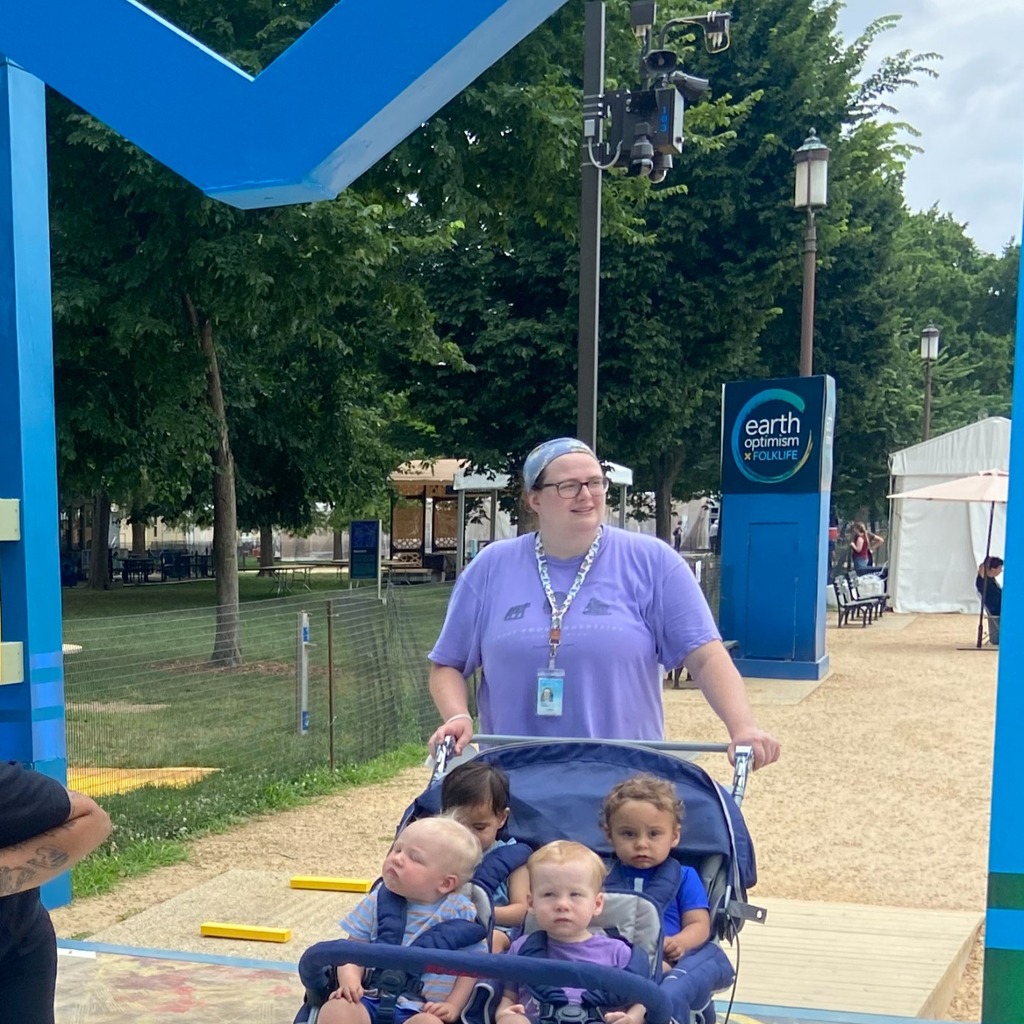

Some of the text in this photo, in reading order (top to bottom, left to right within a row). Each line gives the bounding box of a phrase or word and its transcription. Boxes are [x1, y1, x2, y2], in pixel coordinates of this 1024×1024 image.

[745, 411, 800, 435] earth
[744, 434, 799, 451] optimism
[752, 450, 798, 461] FOLKLIFE
